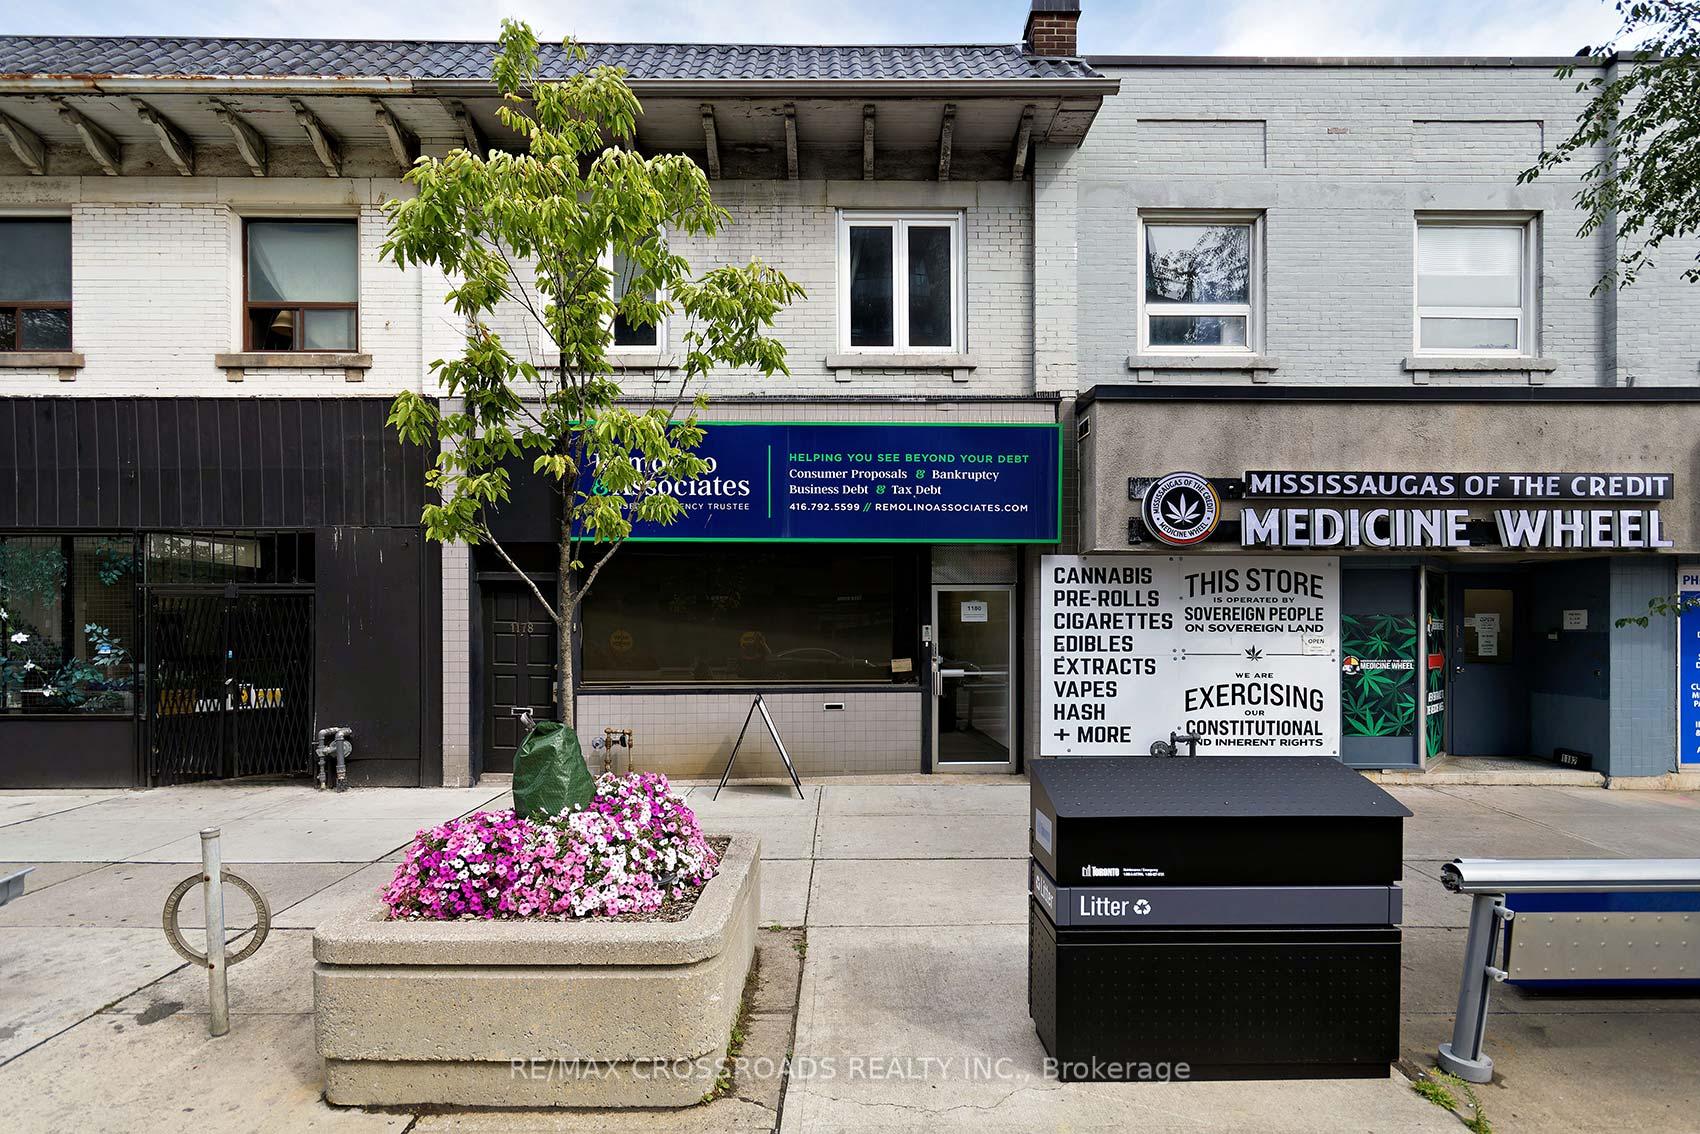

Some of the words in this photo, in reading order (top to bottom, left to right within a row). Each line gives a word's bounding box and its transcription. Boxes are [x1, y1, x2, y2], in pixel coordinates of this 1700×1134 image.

[789, 453, 842, 463] HELPING
[847, 453, 873, 463] YOU
[877, 453, 900, 463] SEE
[905, 453, 956, 464] BEYOND
[960, 454, 993, 464] YOUR
[997, 454, 1029, 464] DEBT
[789, 468, 849, 479] Consumer
[851, 468, 908, 481] Proposals
[915, 469, 926, 480] &
[932, 469, 1000, 482] Bankruptcy
[789, 484, 840, 495] Business
[842, 484, 869, 495] Debt
[875, 484, 886, 495] &
[891, 485, 912, 495] Tax
[915, 485, 942, 495] Debt
[1251, 474, 1456, 496] MISSISSAUGAS
[1464, 475, 1500, 496] OF
[1509, 476, 1560, 496] THE
[1571, 476, 1669, 497] CREDIT
[1152, 479, 1183, 514] MISSISSAUGAS
[1183, 479, 1193, 487] OF
[1193, 481, 1205, 494] THE
[1202, 491, 1214, 514] CREDIT
[708, 502, 750, 512] TRUSTEE
[789, 502, 860, 512] 416.792.5599
[875, 503, 1028, 513] REMOLINOASSOCIATES.COM
[1158, 521, 1189, 538] MEDICINE
[1188, 521, 1209, 536] WHEEL
[1241, 508, 1470, 548] MEDICINE
[1495, 509, 1675, 548] WHEEL
[1053, 567, 1153, 585] CANNABIS
[1184, 569, 1239, 598] THIS
[1246, 568, 1324, 600] STORE
[1053, 590, 1160, 607] PRE-ROLLS
[1053, 613, 1173, 630] CIGARETTES
[1184, 606, 1265, 621] SOVEREIGN
[1269, 607, 1324, 621] PEOPLE
[511, 622, 534, 633] 1178
[1184, 624, 1204, 632] ON
[1208, 624, 1284, 632] SOVEREIGN
[1288, 624, 1324, 632] LAND
[1053, 636, 1134, 652] EDIBLES
[1053, 658, 1156, 675] EXTRACTS
[1360, 662, 1391, 670] MEDICINE
[1391, 662, 1415, 670] WHEEL
[1053, 681, 1118, 698] VAPES
[1185, 682, 1324, 712] EXERCISING
[1053, 704, 1106, 720] HASH
[1077, 727, 1132, 743] MORE
[1186, 720, 1323, 736] CONSTITUTIONAL
[1280, 739, 1324, 747] RIGHTS
[1080, 895, 1130, 916] Litter
